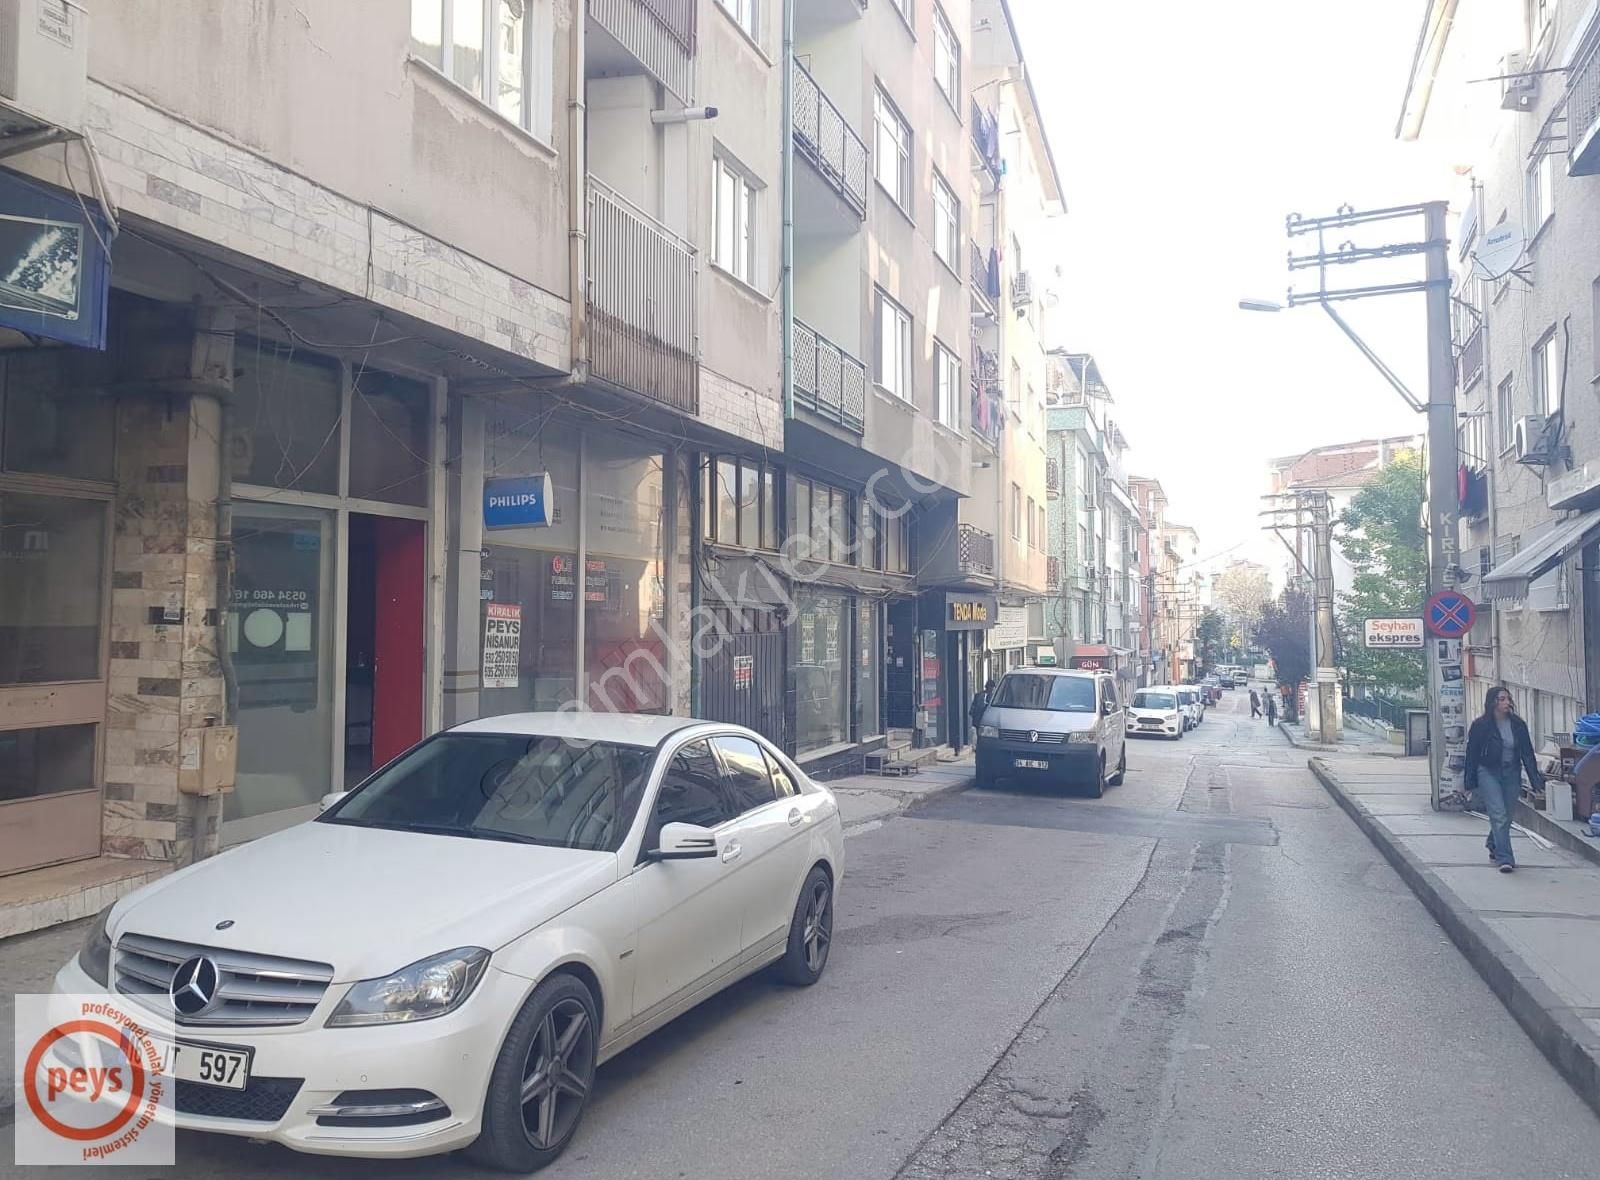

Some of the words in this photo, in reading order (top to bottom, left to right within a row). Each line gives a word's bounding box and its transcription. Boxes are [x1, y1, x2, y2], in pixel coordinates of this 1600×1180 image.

[489, 494, 537, 508] PHILIPS
[487, 605, 521, 618] KİRALIK
[953, 602, 972, 621] TENDA
[973, 602, 987, 621] Moda
[487, 619, 520, 634] PEYS
[1371, 620, 1416, 633] Seyhan
[486, 633, 519, 649] NİSANUR
[1369, 632, 1421, 644] ekspres
[199, 1051, 242, 1084] 597
